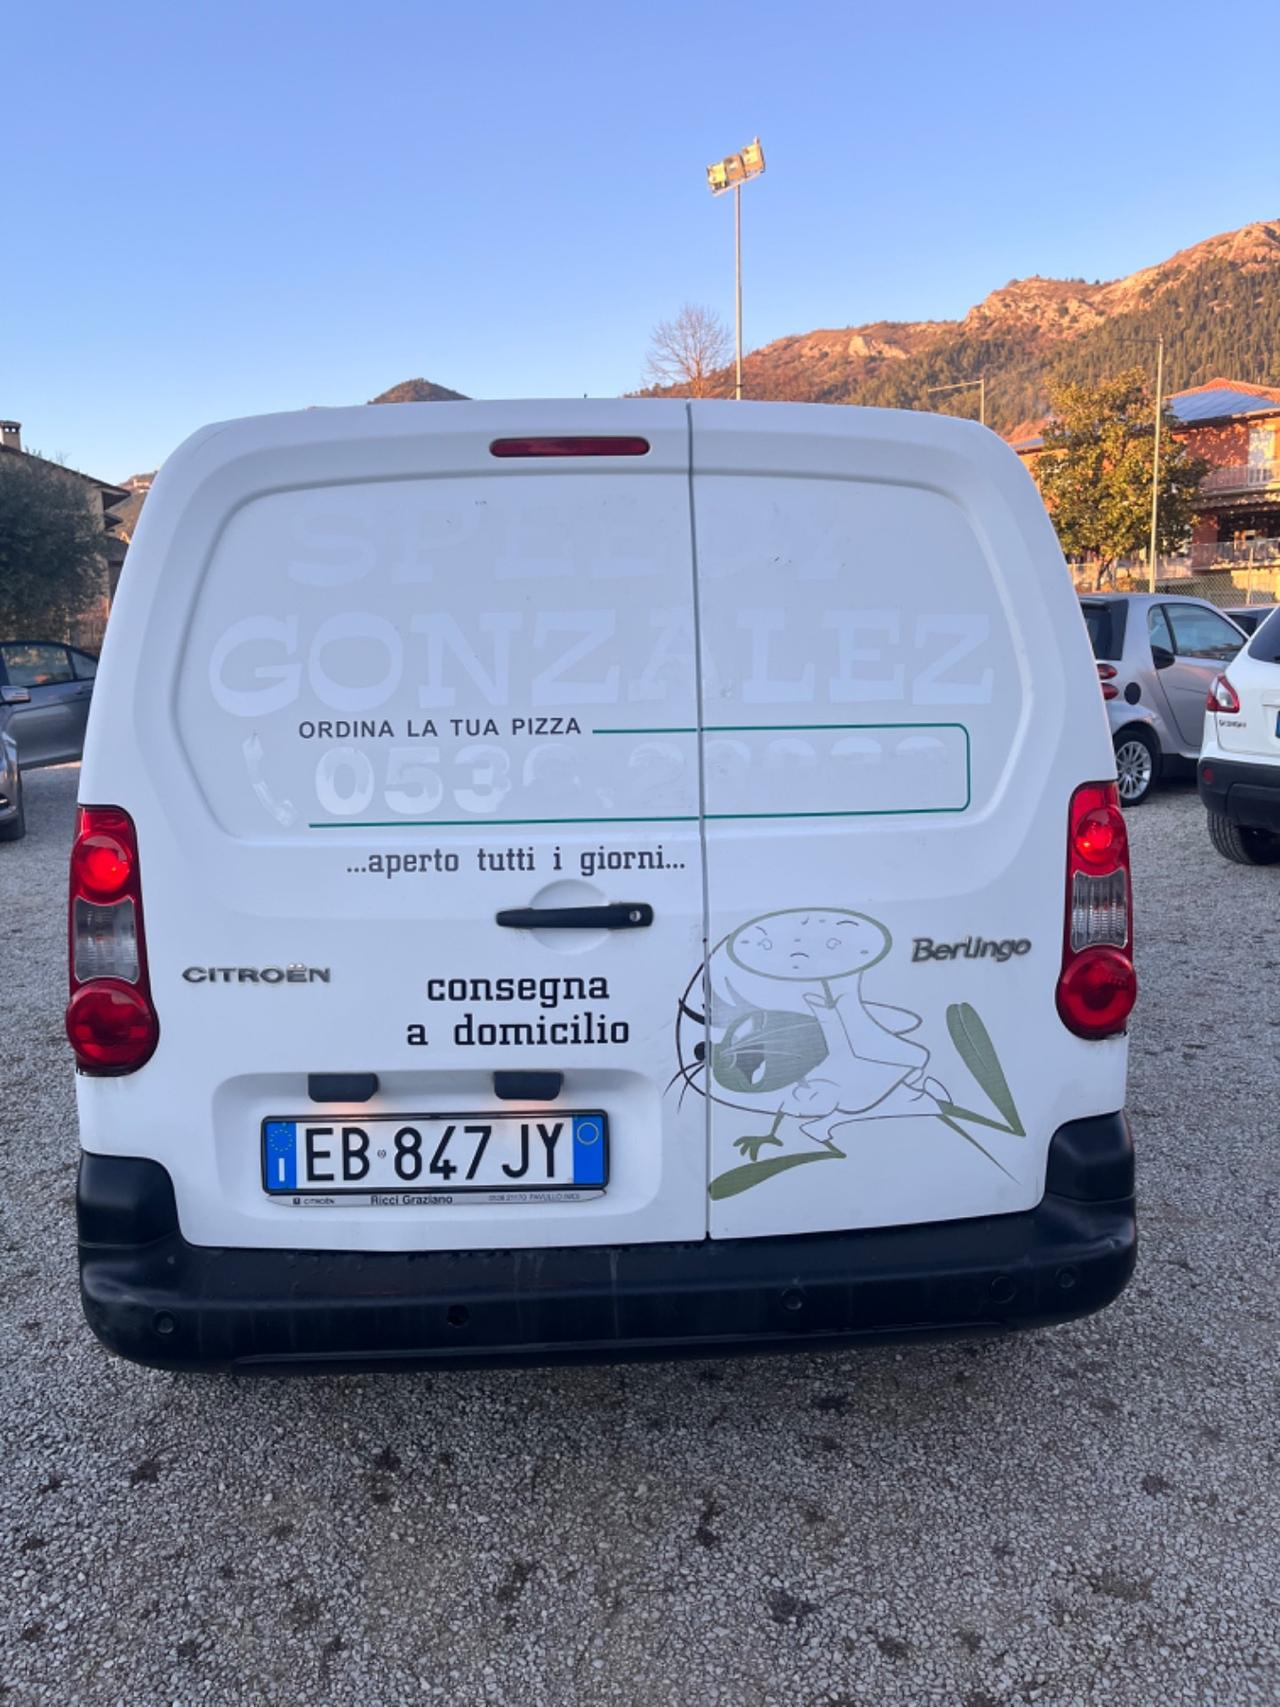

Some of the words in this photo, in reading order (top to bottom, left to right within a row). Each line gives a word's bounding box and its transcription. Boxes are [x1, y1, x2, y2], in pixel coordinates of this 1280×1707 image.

[208, 607, 994, 716] GONZALEZ
[298, 720, 395, 738] ORDINA
[407, 720, 438, 738] LA
[450, 719, 500, 737] TUA
[512, 718, 582, 736] PIZZA
[477, 847, 536, 872] tutti
[554, 846, 563, 871] i
[911, 936, 1032, 963] Berlingo
[427, 976, 610, 1009] consegna
[407, 1023, 429, 1046] a
[454, 1012, 629, 1045] domicilio
[305, 1127, 370, 1182] EB
[370, 1194, 400, 1205] Ricci
[402, 1194, 454, 1205] Graziano
